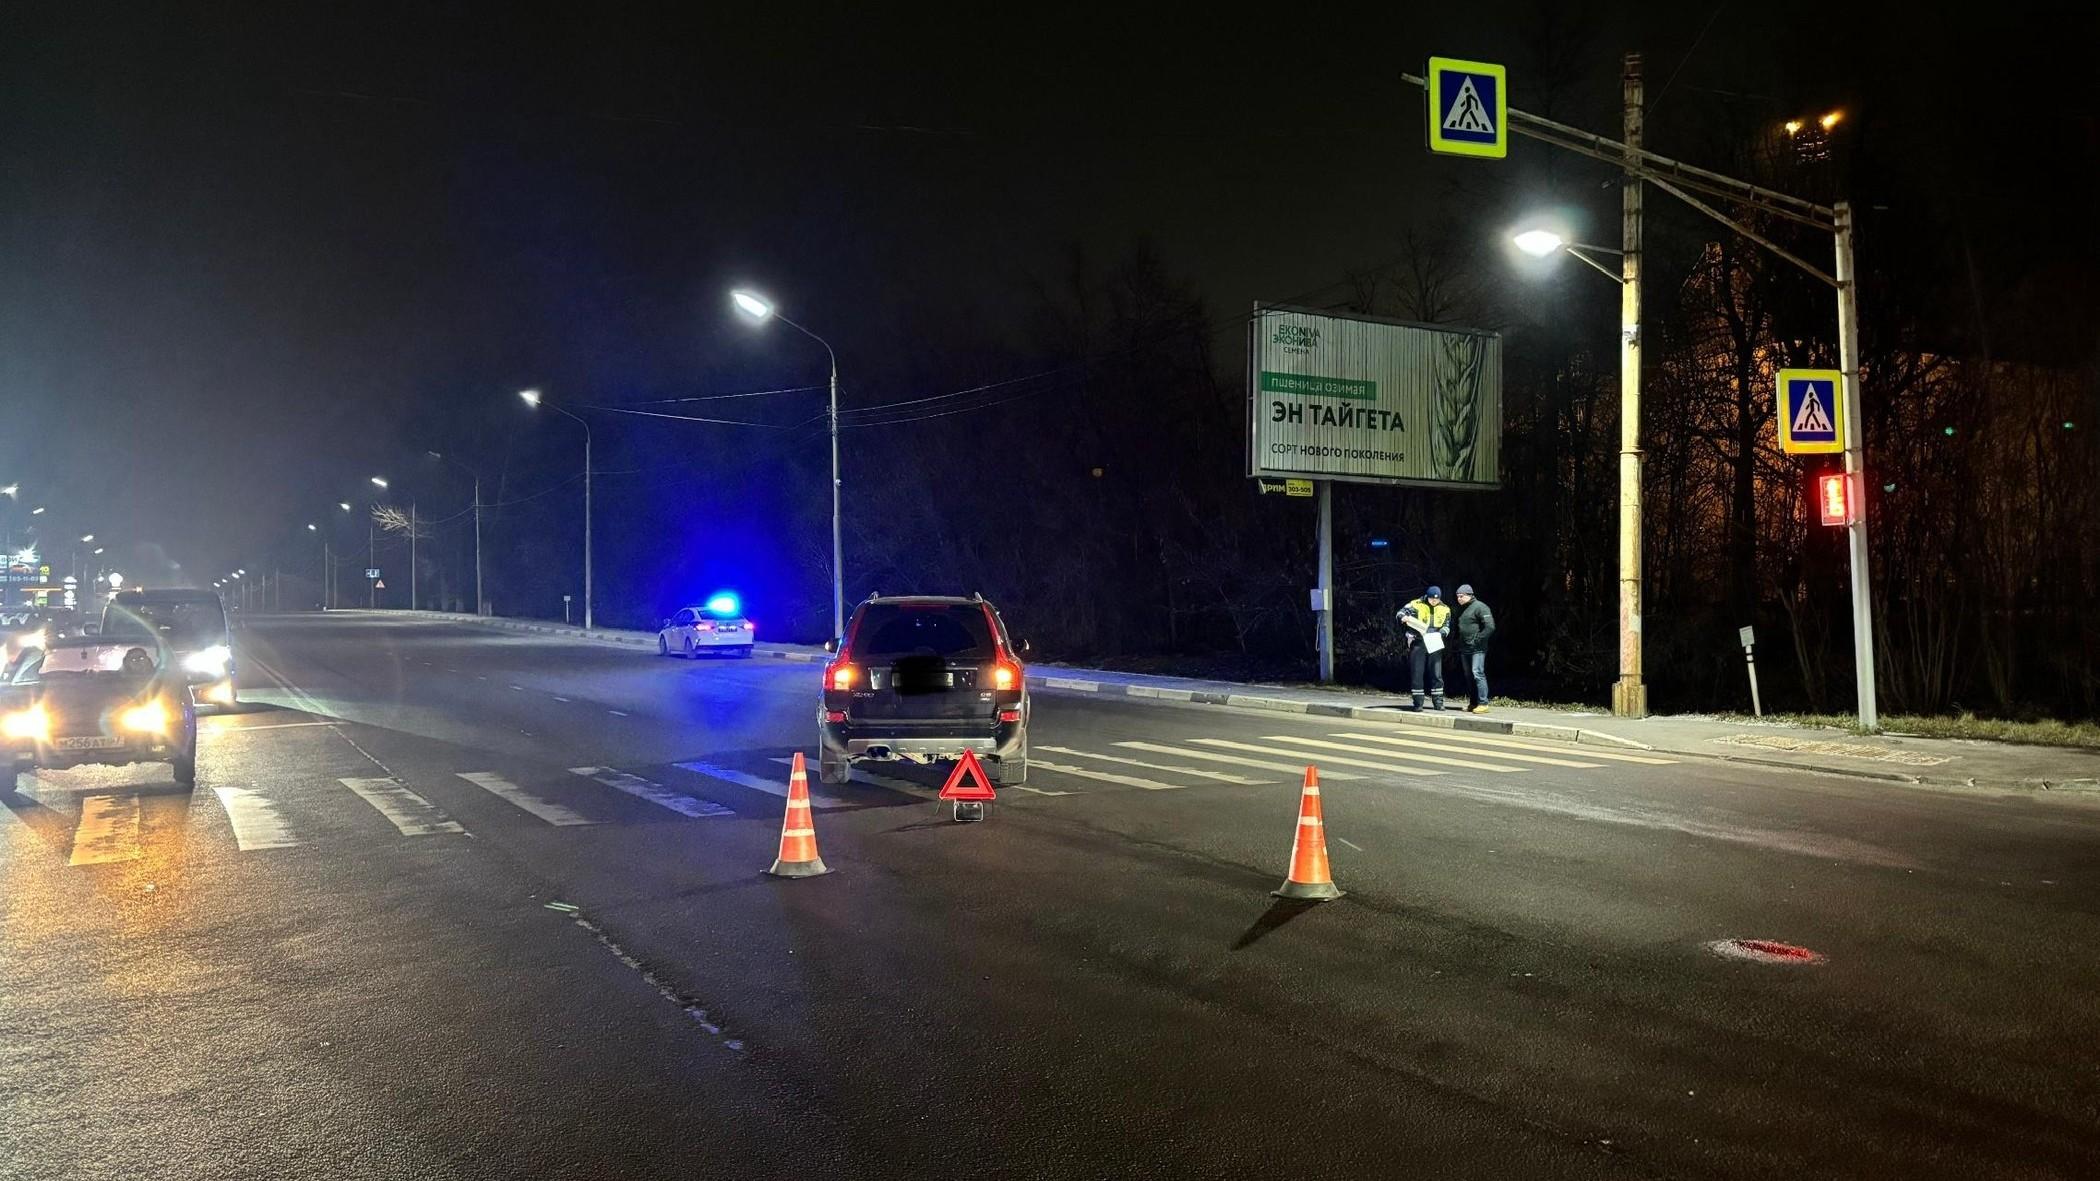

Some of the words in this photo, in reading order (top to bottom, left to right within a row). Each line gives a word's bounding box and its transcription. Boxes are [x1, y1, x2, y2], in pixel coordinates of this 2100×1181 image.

[1279, 324, 1321, 338] EKONIVA
[1272, 334, 1318, 348] ЭКОНИВА
[1325, 382, 1366, 396] озимая
[1271, 400, 1303, 424] ЭН
[1308, 401, 1405, 433] ТАЙГЕТА
[1271, 443, 1298, 455] СОРТ
[1300, 445, 1343, 458] НОВОГО
[1344, 448, 1405, 463] ПОКОЛЕНИЯ
